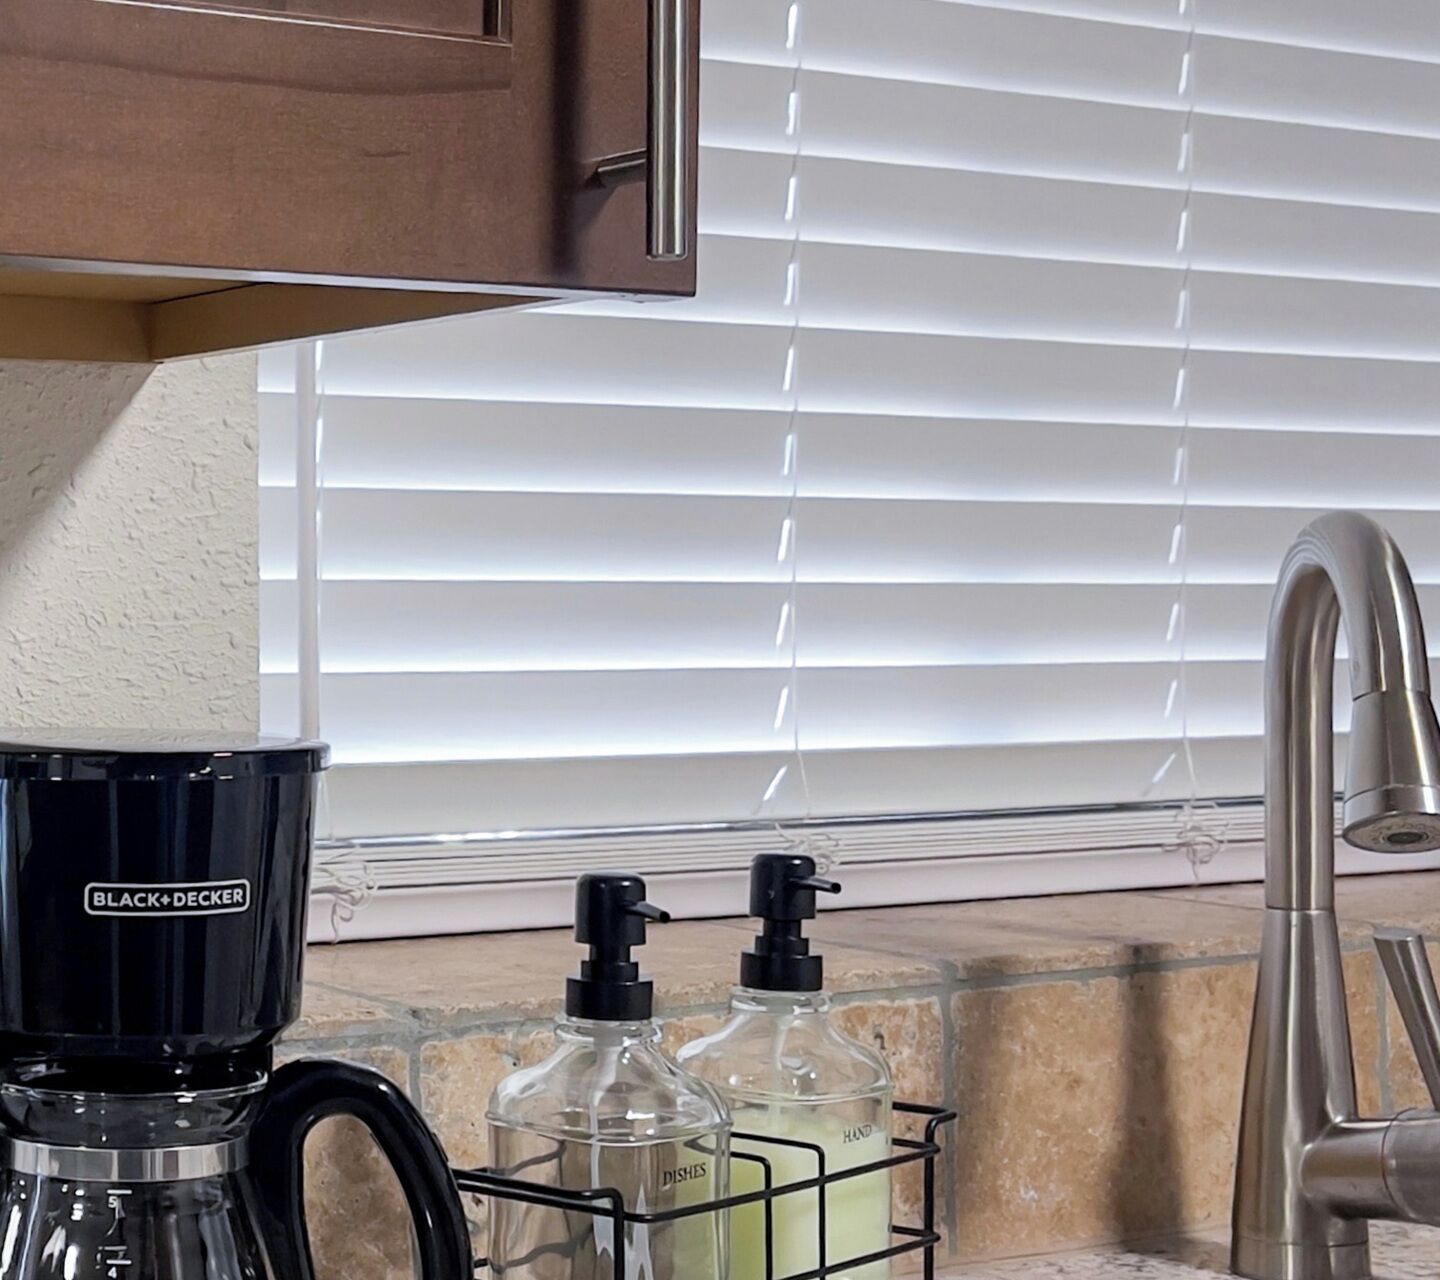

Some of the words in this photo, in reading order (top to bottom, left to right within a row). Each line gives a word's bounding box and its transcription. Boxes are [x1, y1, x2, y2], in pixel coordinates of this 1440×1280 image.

[93, 888, 244, 908] BLACK+DECKER
[843, 1124, 872, 1143] HAND
[663, 1163, 706, 1185] DISHES
[107, 1266, 118, 1279] 4
